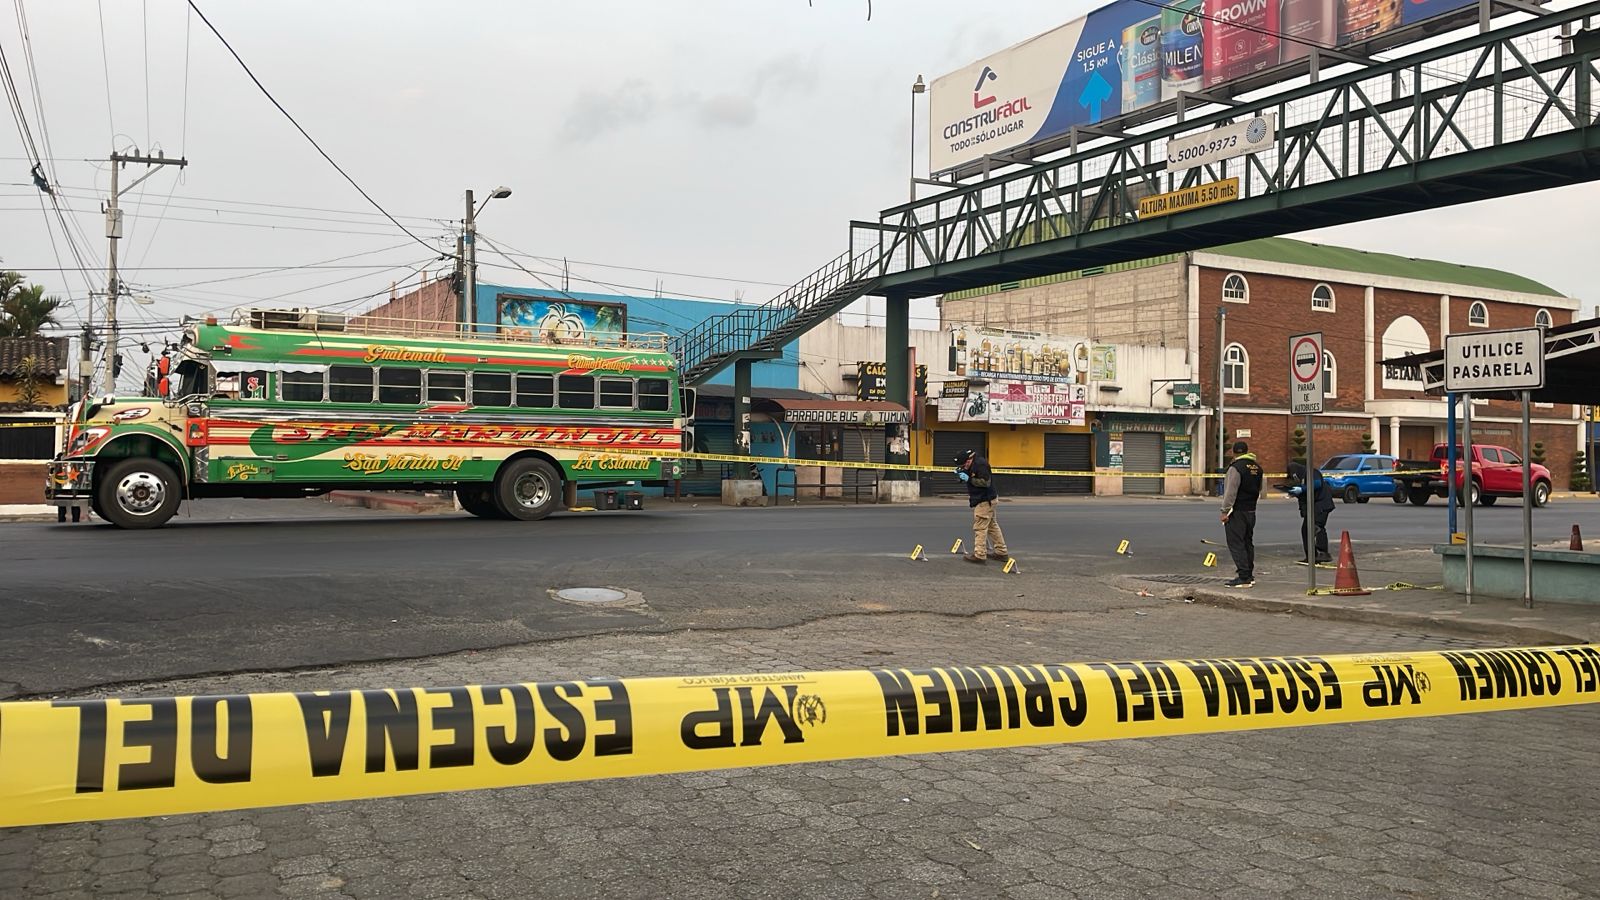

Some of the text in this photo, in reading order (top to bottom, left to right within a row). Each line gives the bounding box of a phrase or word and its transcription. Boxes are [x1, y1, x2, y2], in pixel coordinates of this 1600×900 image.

[1212, 0, 1266, 26] CROWN
[1077, 39, 1115, 62] SIGUE A
[1083, 56, 1108, 73] 1.5 KM
[950, 138, 971, 153] TODO
[975, 130, 996, 144] SÓLO
[997, 119, 1024, 137] LUGAR
[1178, 135, 1237, 161] 5000-9373
[1140, 183, 1236, 215] ALTURA MAXIMA 5.50 mts.
[364, 344, 447, 364] Guatemala
[1462, 341, 1523, 359] UTILICE
[1453, 362, 1533, 379] PASARELA
[1297, 382, 1316, 392] PARADA
[1303, 393, 1310, 401] DE
[785, 410, 824, 422] PARADA
[825, 411, 838, 422] DE
[840, 411, 858, 422] BUS
[1294, 403, 1320, 412] AUTOBUSES
[342, 453, 381, 471] San
[571, 452, 594, 470] La
[598, 453, 651, 471] Estancia
[683, 674, 806, 686] MINISTERIO PÚBLICO
[1437, 649, 1562, 702] CRIMEN
[1362, 664, 1421, 708] MP
[882, 656, 1342, 737] ESCENA DEL CRIMEN
[681, 686, 805, 750] MP
[51, 679, 633, 794] ESCENA DEL
